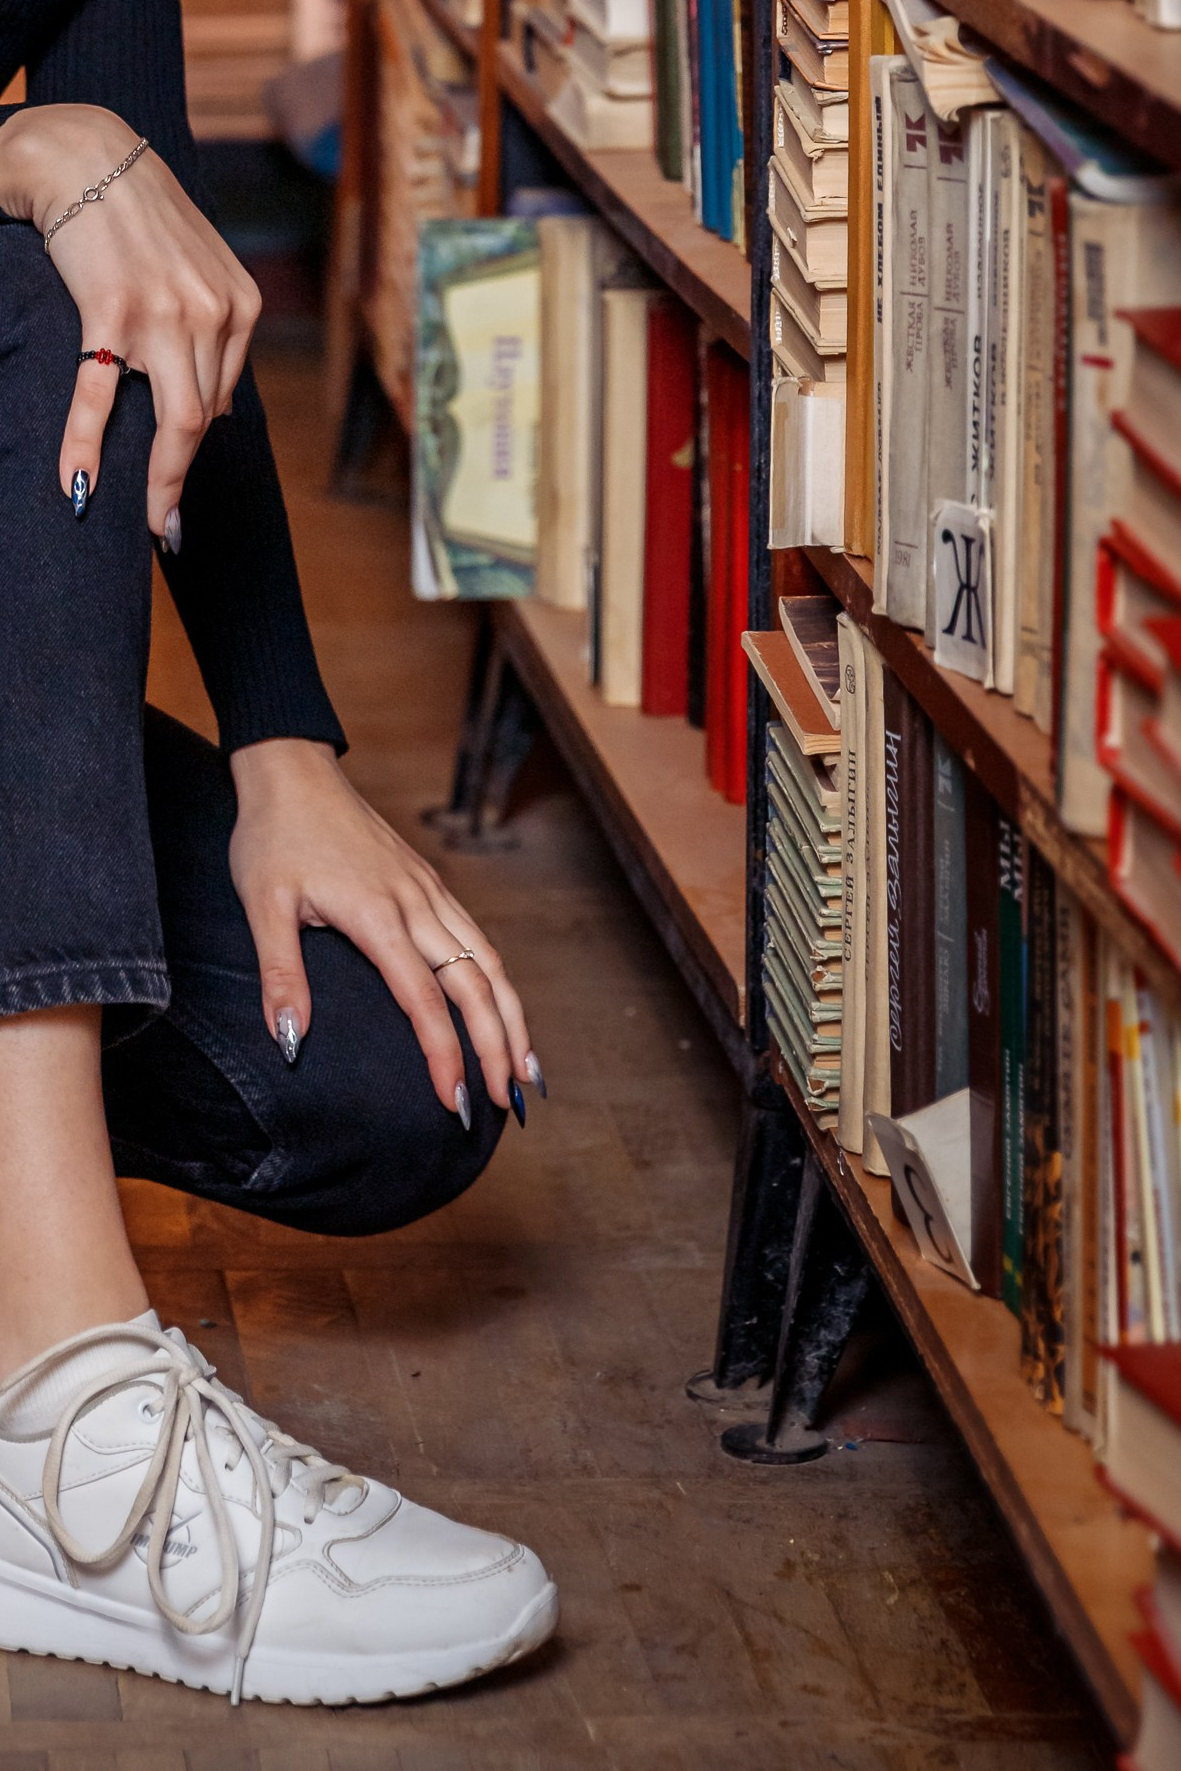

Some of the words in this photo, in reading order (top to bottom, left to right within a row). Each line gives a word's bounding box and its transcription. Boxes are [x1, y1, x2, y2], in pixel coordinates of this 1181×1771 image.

[875, 95, 883, 191] ЕДИНЫМ
[876, 202, 884, 287] ХЛЕБОМ
[908, 209, 918, 287] НИКОЛАЙ
[917, 236, 926, 288] ДУБОВ
[944, 222, 954, 303] НИКОЛАЙ
[952, 250, 961, 304] ДУБОВ
[876, 298, 884, 324] НЕ
[905, 301, 917, 374] ЖЕСТКАЯ
[914, 302, 924, 353] ПРОБА
[941, 316, 953, 390] ЖЕСТКАЯ
[971, 334, 982, 472] ЖИТКОВ
[941, 528, 988, 650] Ж
[845, 748, 856, 865] ЗАЛЫГИН
[885, 729, 902, 921] Залыгин
[999, 819, 1012, 891] МЫ
[843, 874, 855, 963] СЕРГЕЙ
[887, 918, 902, 1052] Сергей
[1004, 1049, 1012, 1135] ЗАМЯТИН
